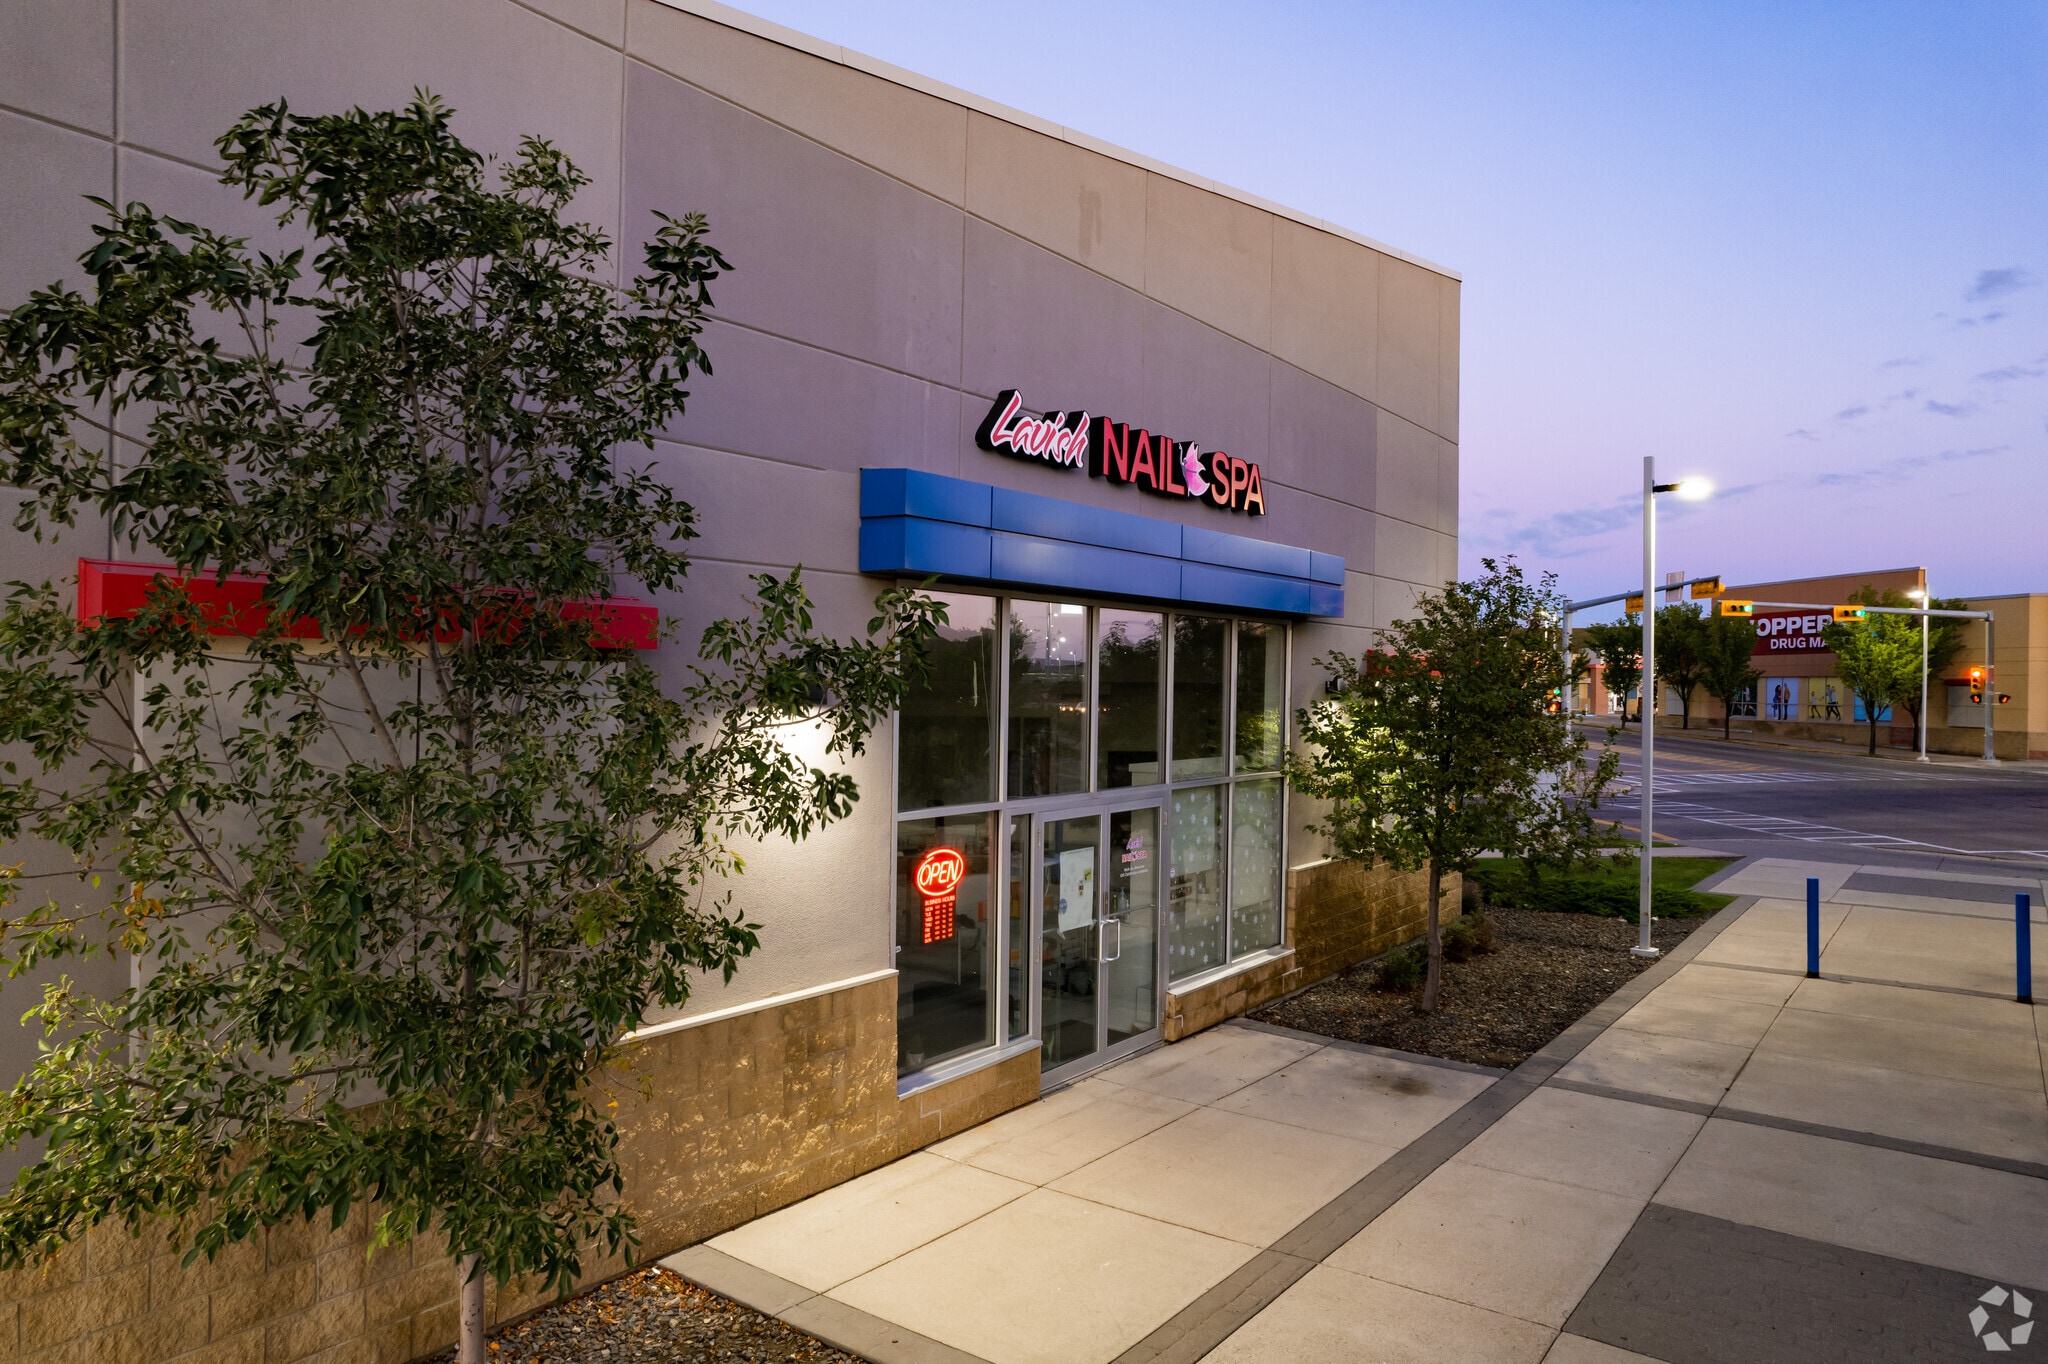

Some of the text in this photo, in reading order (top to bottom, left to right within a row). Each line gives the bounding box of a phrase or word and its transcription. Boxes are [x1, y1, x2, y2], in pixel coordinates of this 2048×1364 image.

[989, 389, 1266, 516] Lavish NAIL SPA
[1750, 614, 1833, 637] OPPER
[1770, 637, 1807, 650] DRUG
[919, 859, 960, 886] OPEN
